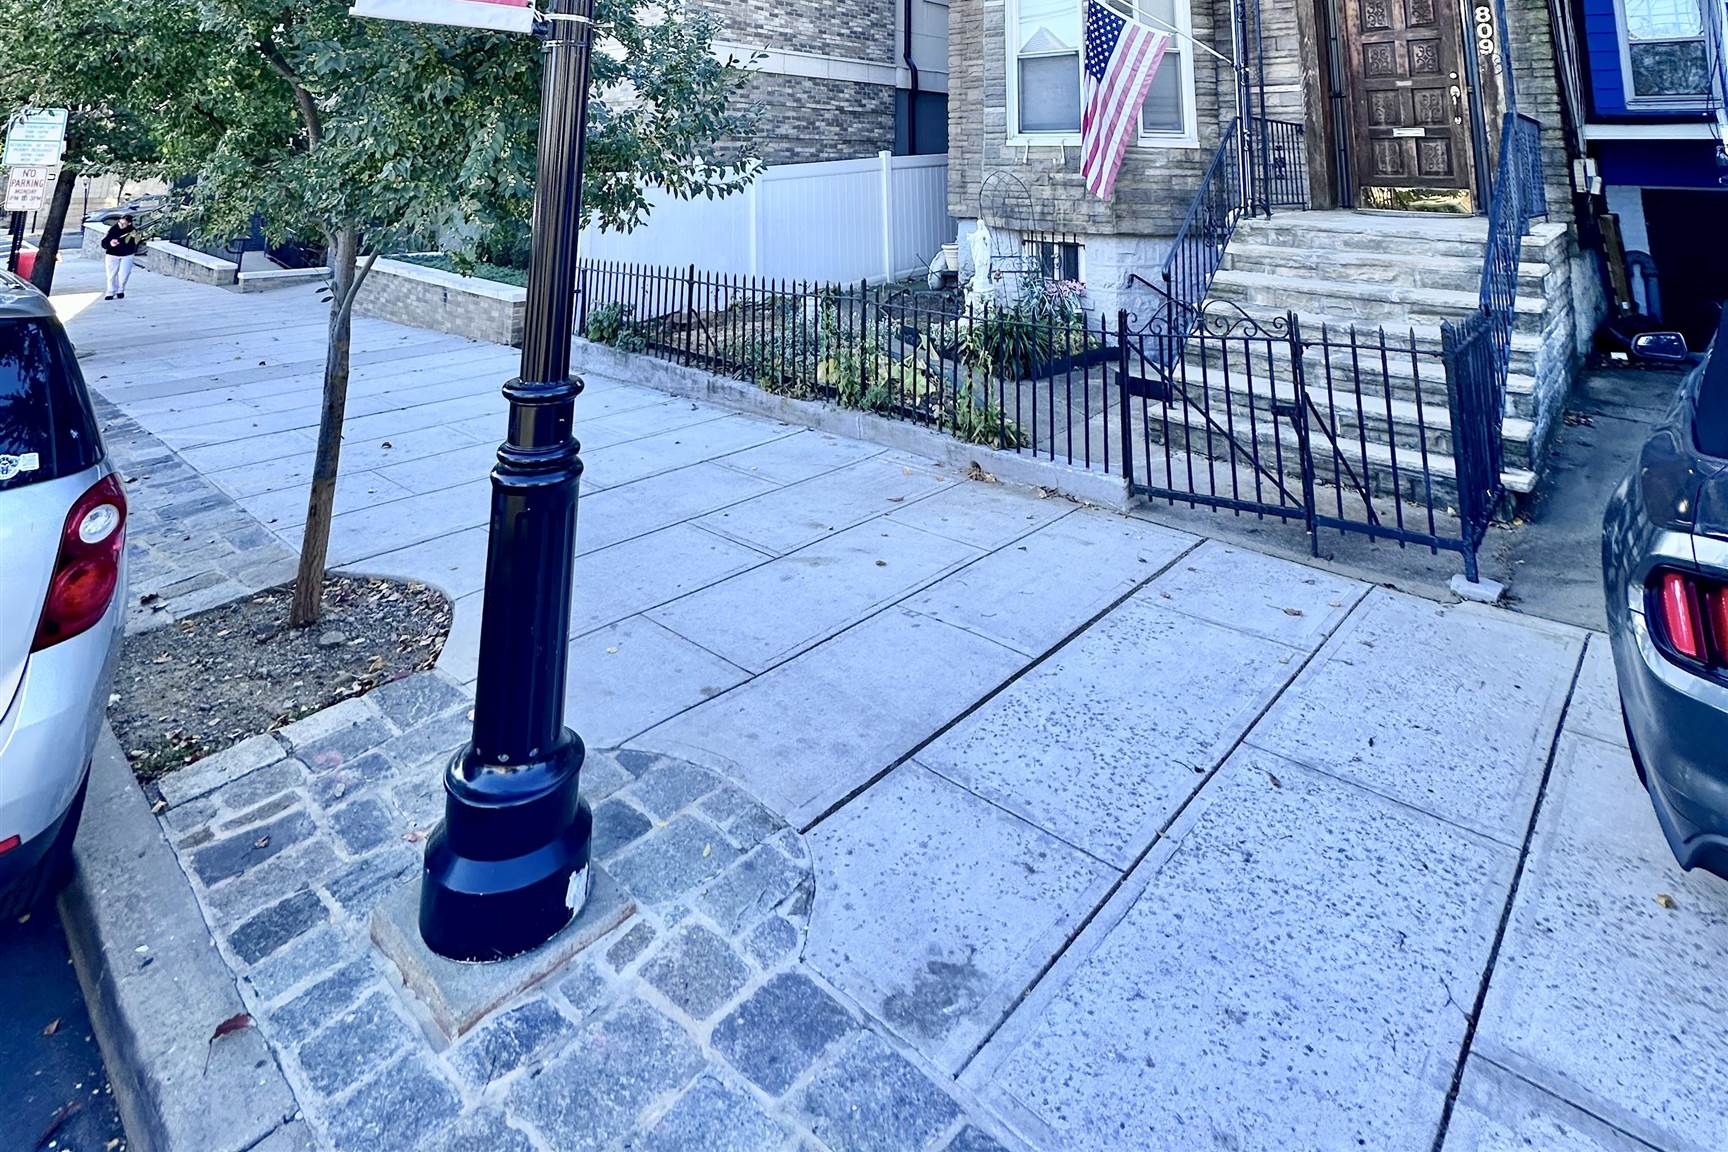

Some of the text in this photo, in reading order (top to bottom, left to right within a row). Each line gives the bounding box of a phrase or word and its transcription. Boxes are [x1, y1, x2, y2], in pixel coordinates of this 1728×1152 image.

[1475, 6, 1494, 55] 809
[22, 169, 37, 178] NO
[10, 179, 44, 188] PARKING
